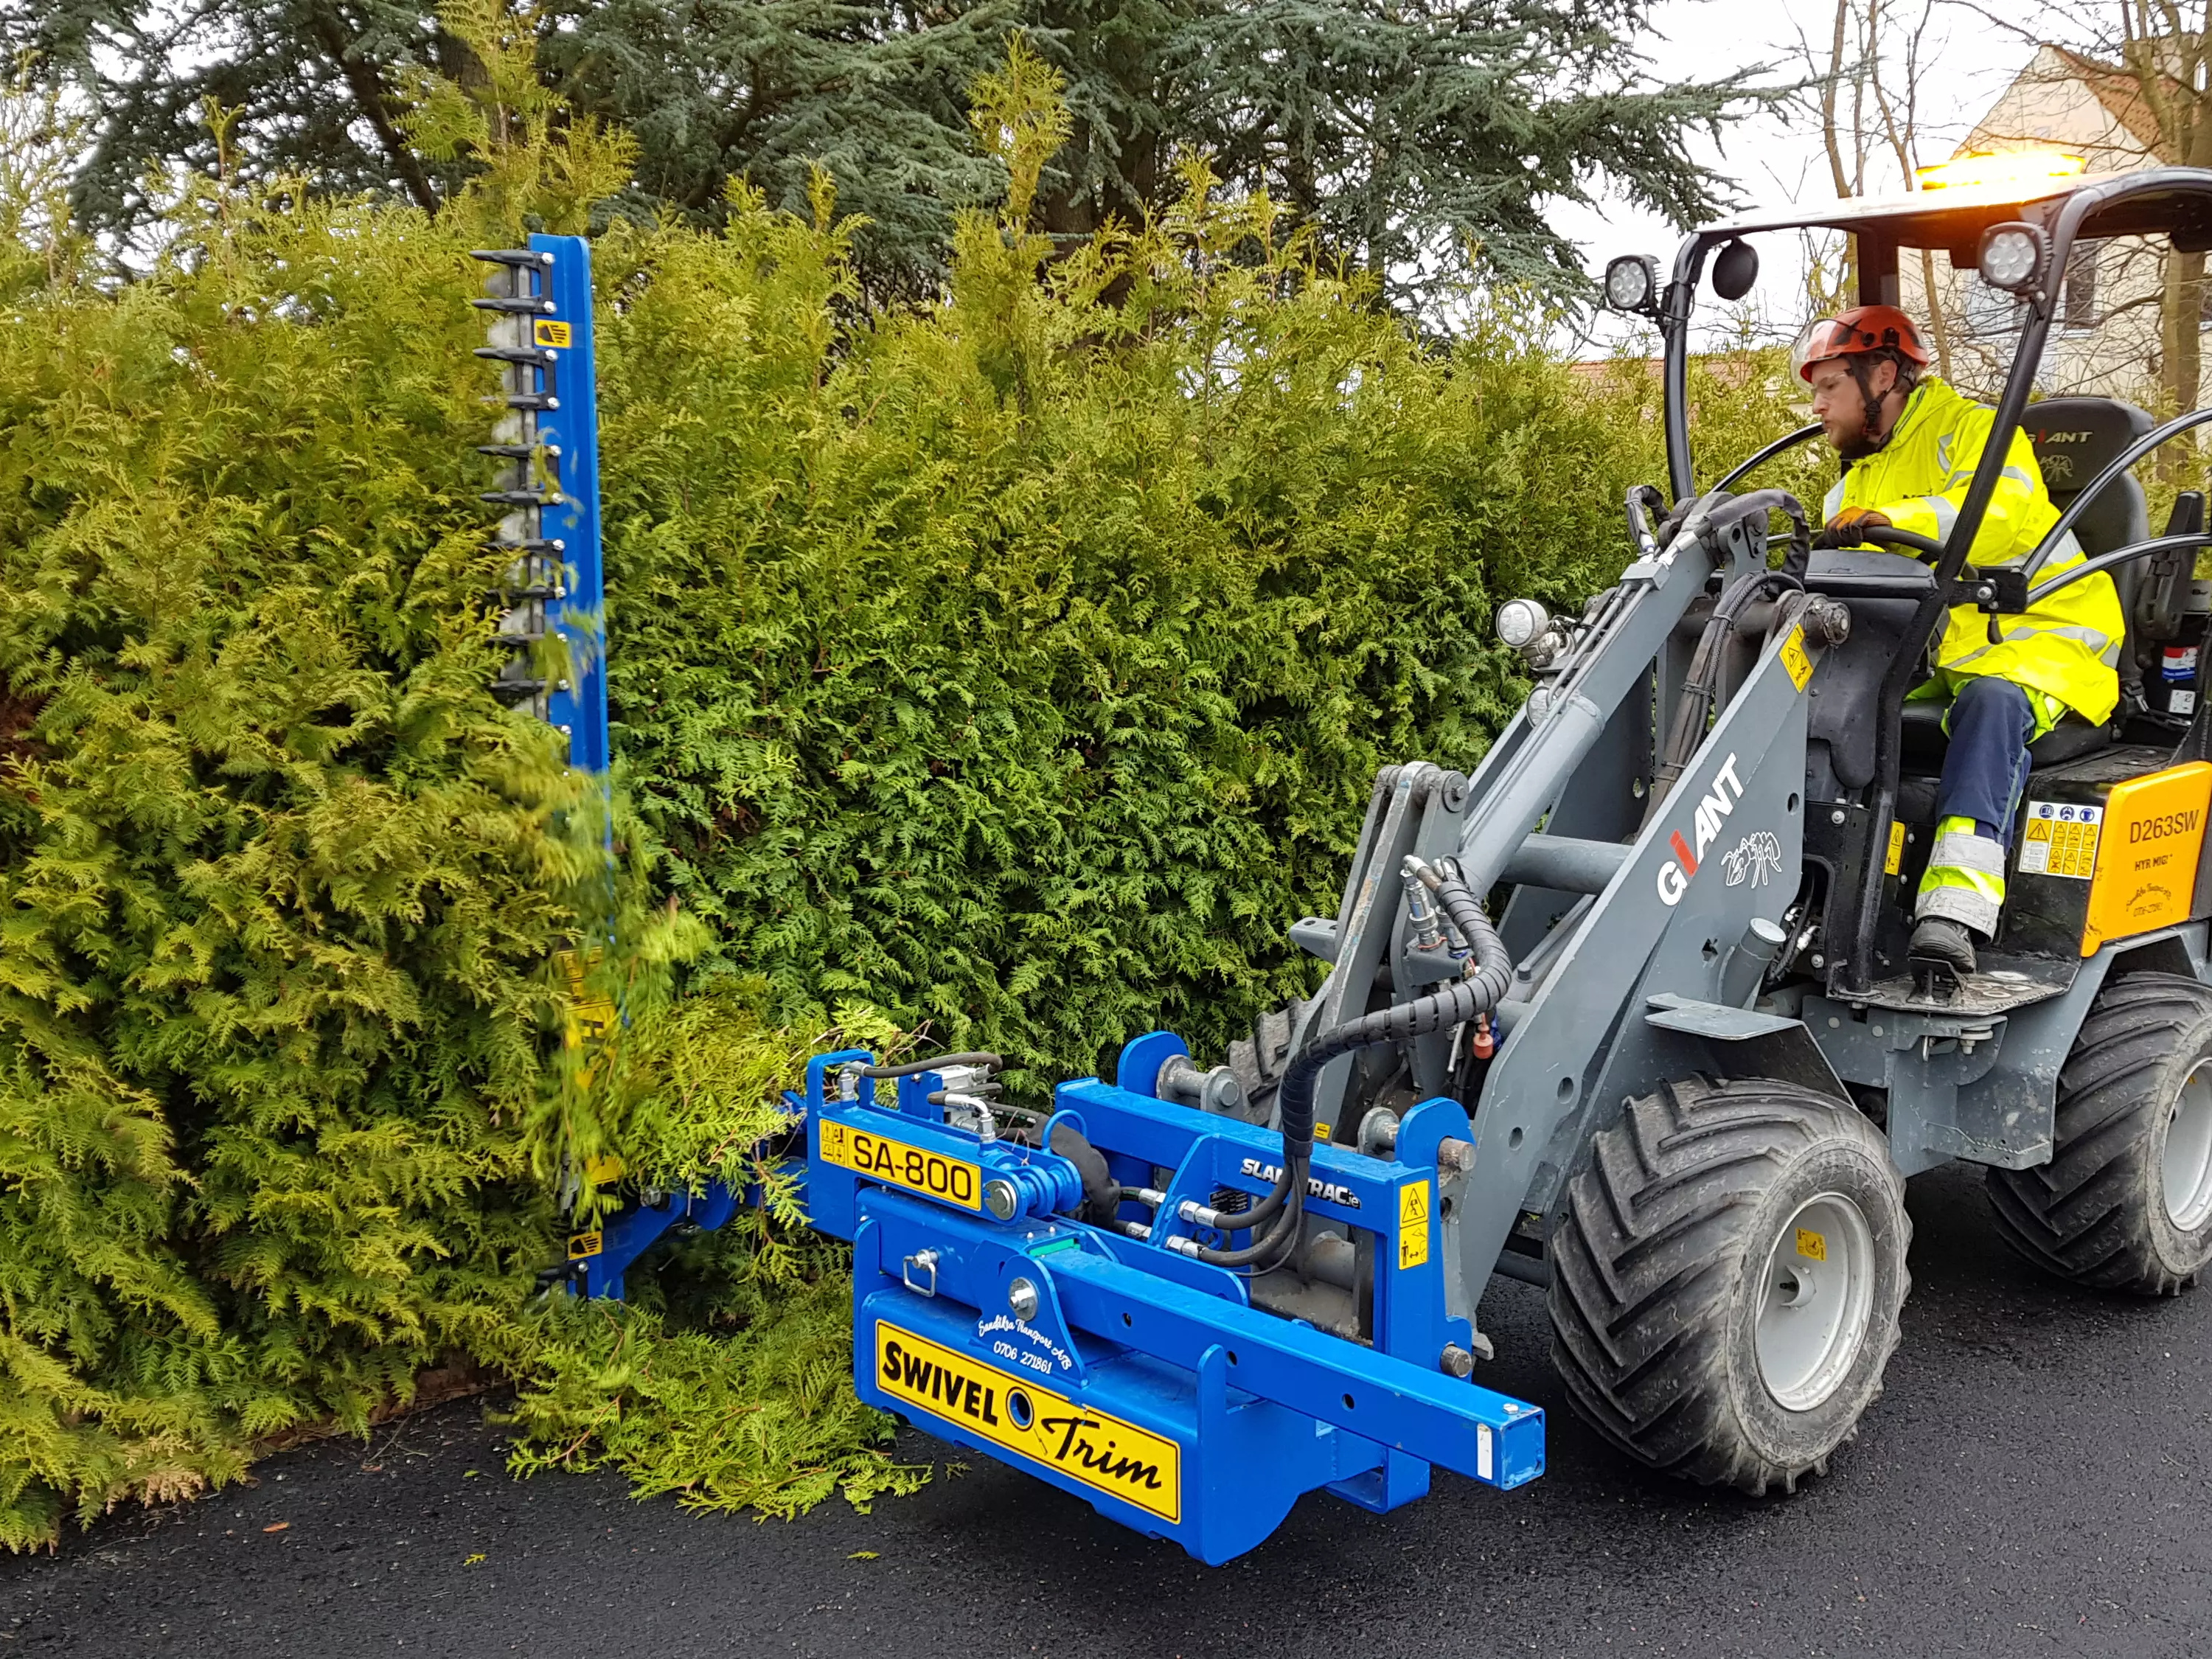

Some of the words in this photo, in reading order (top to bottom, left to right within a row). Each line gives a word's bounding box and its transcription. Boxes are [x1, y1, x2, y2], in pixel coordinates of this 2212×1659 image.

[1657, 751, 1744, 907] GIANT
[2130, 810, 2199, 844] D263SW
[853, 1135, 972, 1202] SA-800
[993, 1340, 1018, 1360] 0706
[1019, 1351, 1053, 1374] 271861
[1051, 1347, 1073, 1371] AB
[882, 1340, 999, 1427] SWIVEL
[1040, 1416, 1163, 1490] Trim
